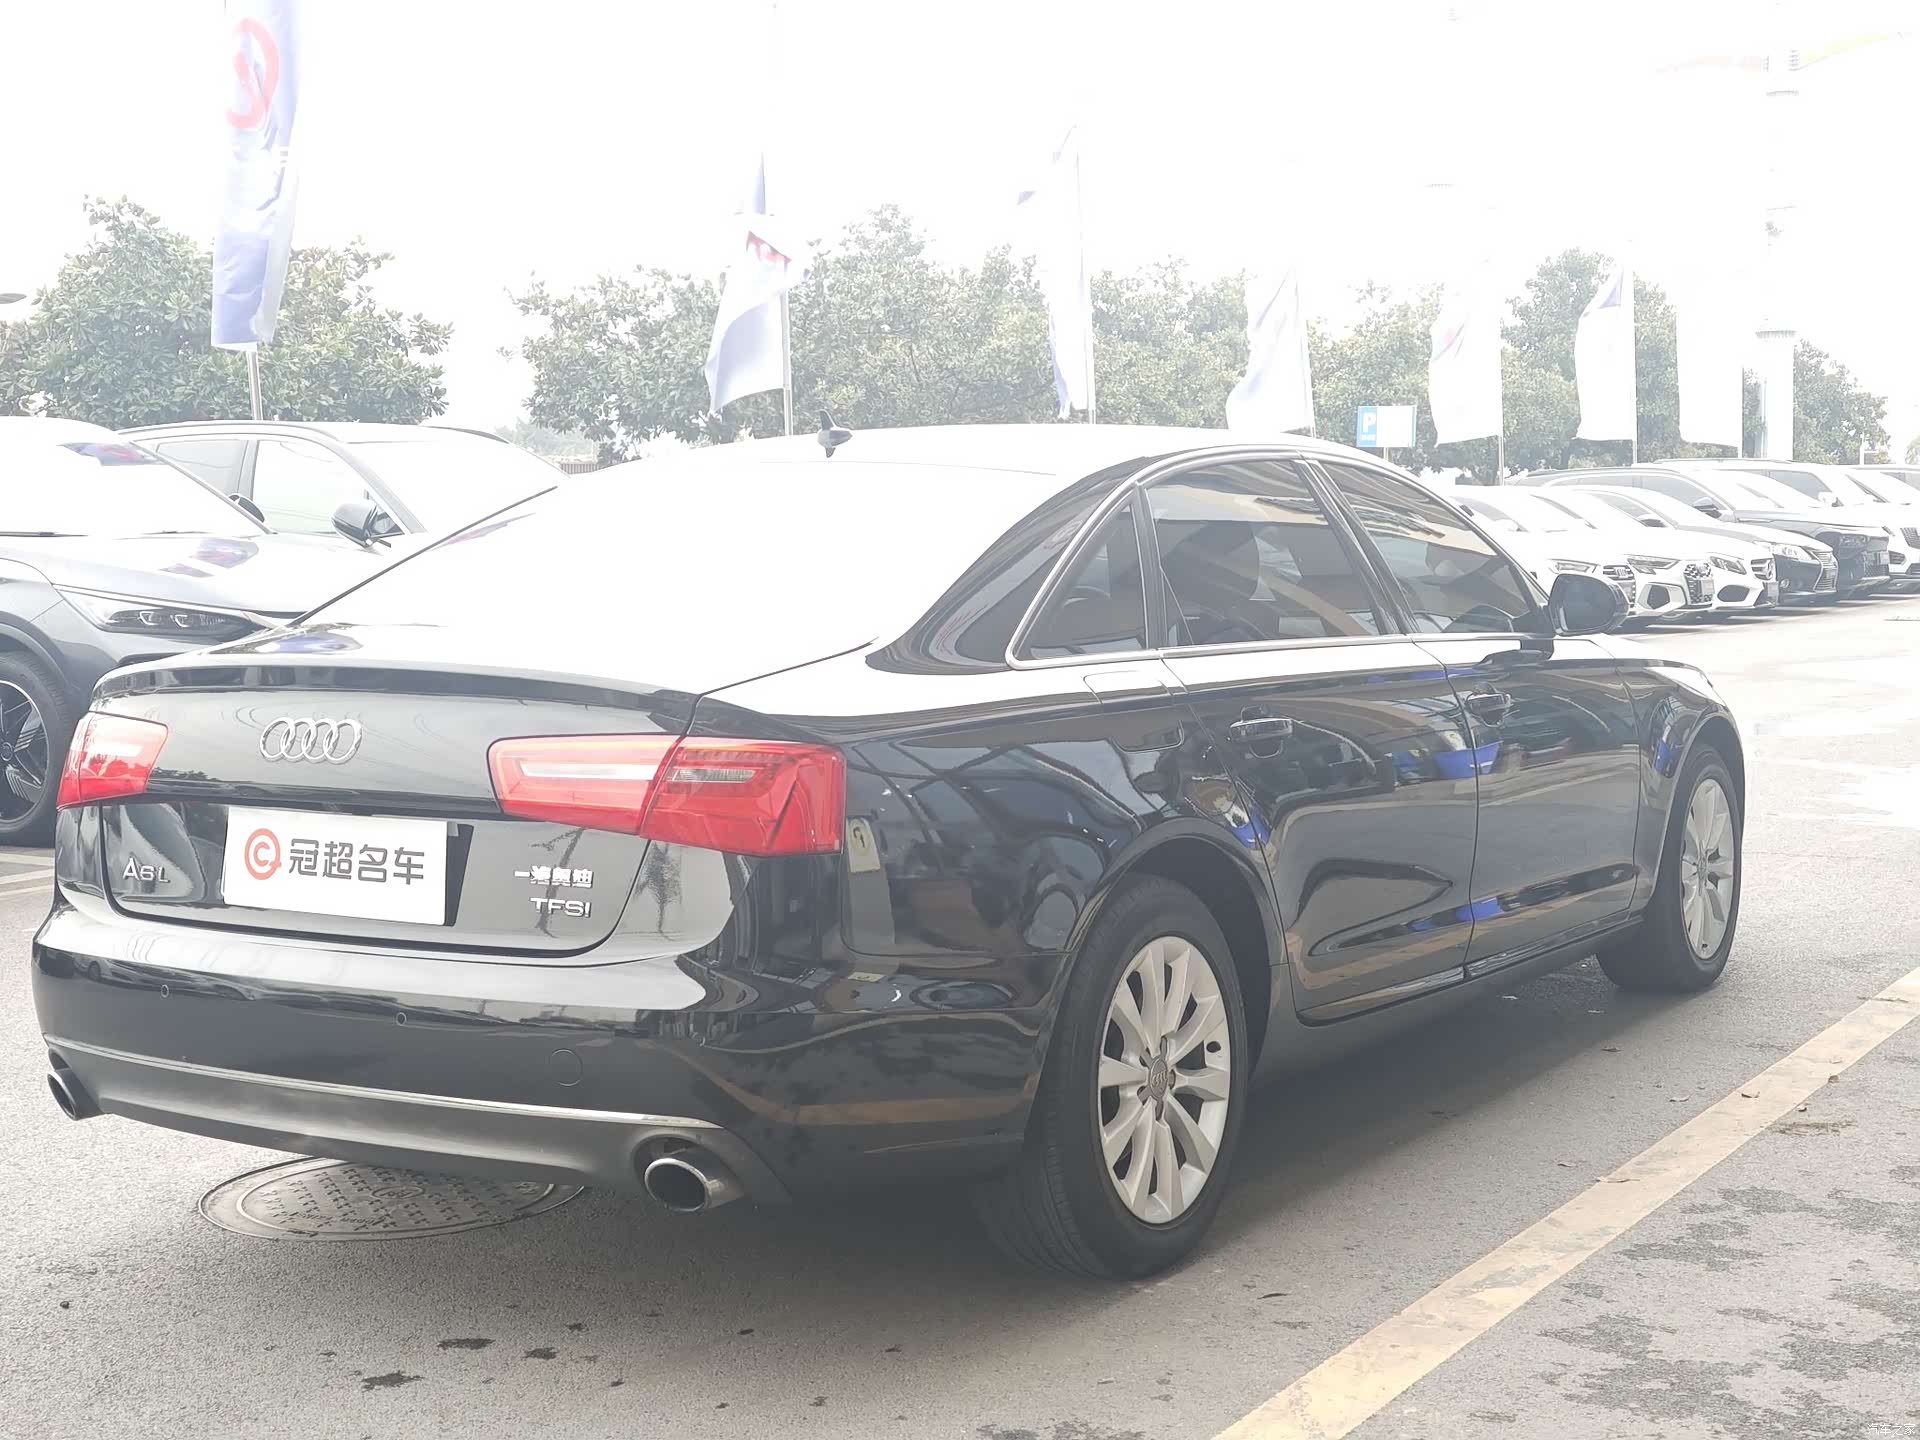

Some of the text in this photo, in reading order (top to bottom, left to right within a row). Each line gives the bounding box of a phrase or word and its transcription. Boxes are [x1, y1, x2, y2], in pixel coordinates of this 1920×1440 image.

[1362, 412, 1377, 433] P
[122, 857, 170, 884] A6L
[288, 838, 425, 885] 冠超名车
[530, 897, 592, 918] TFSI
